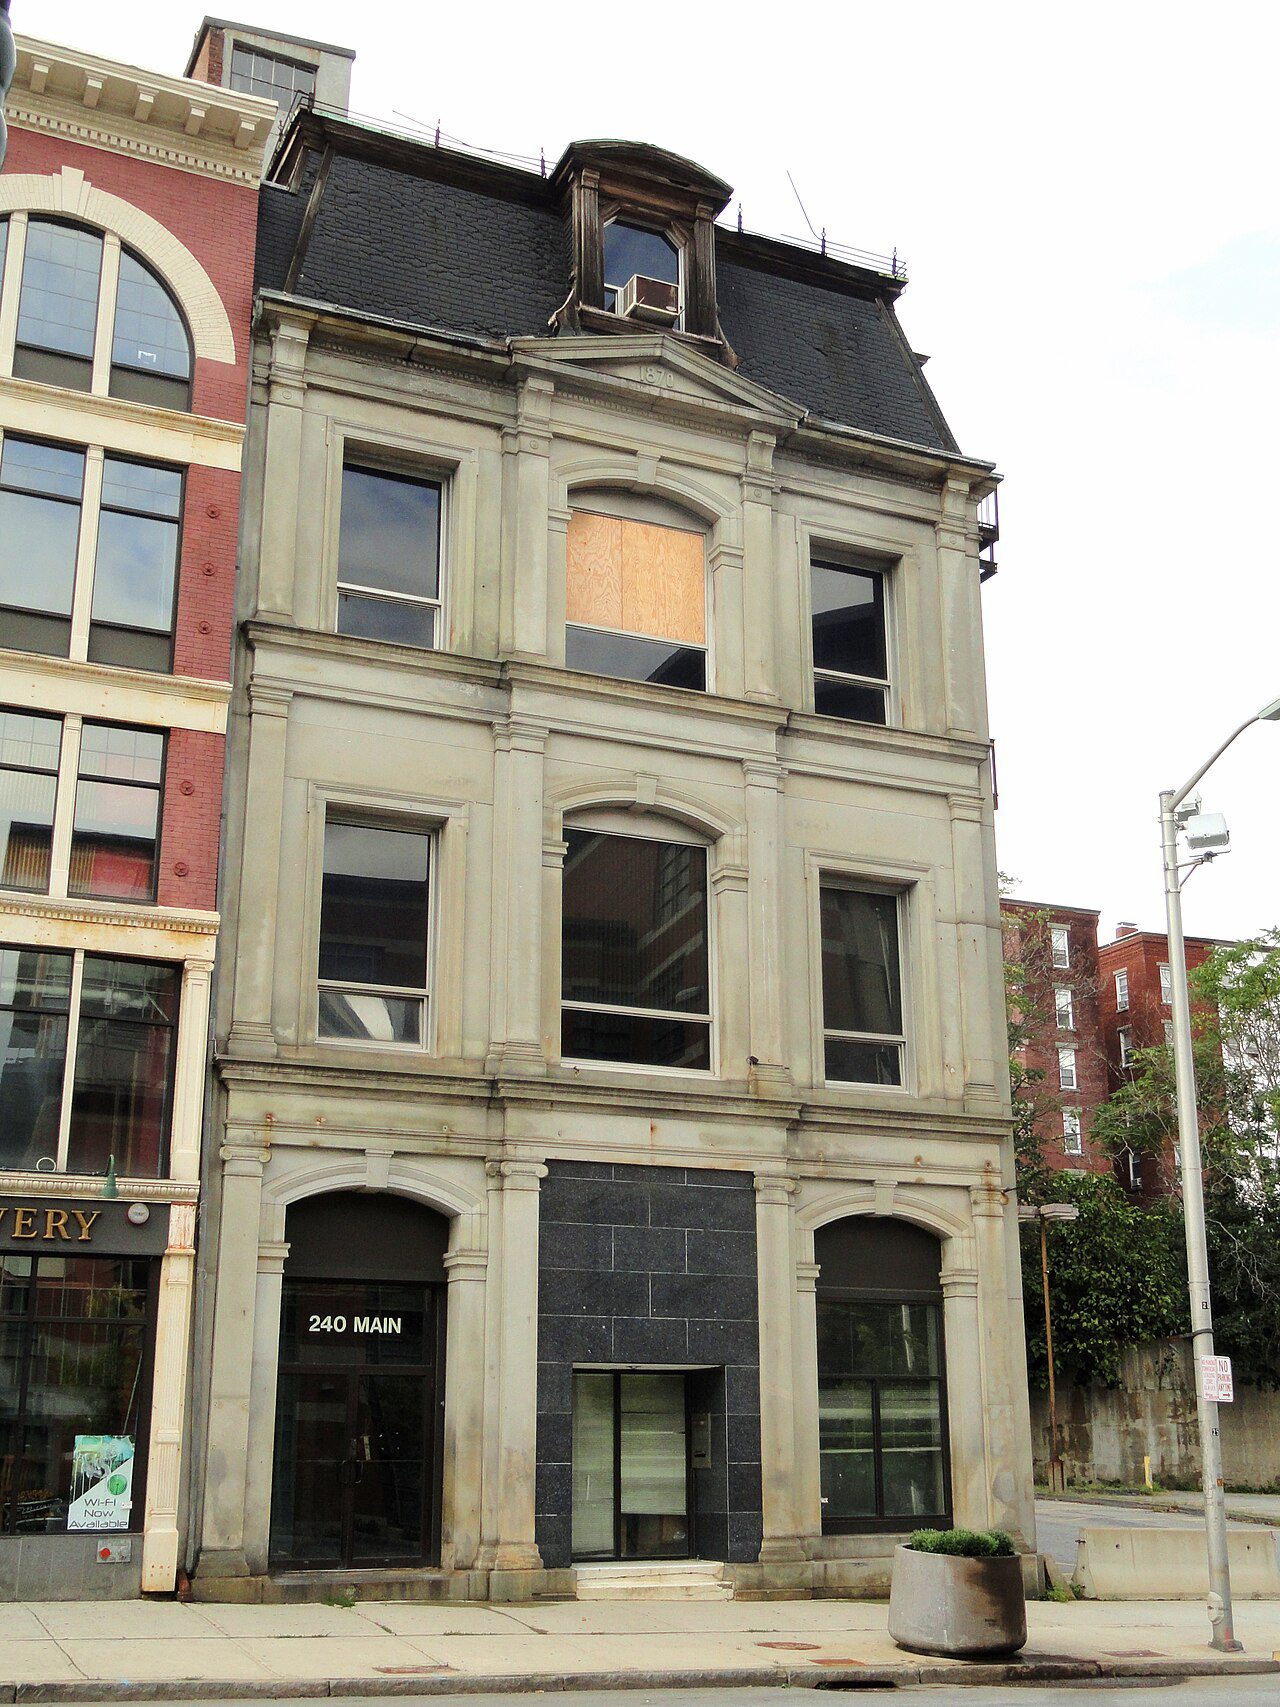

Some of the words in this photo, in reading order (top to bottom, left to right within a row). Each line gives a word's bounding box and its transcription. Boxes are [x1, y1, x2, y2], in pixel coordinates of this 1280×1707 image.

[640, 366, 674, 388] 1870
[308, 1315, 347, 1333] 240
[353, 1316, 402, 1334] MAIN
[1218, 1359, 1229, 1372] NO
[69, 1520, 128, 1529] Available
